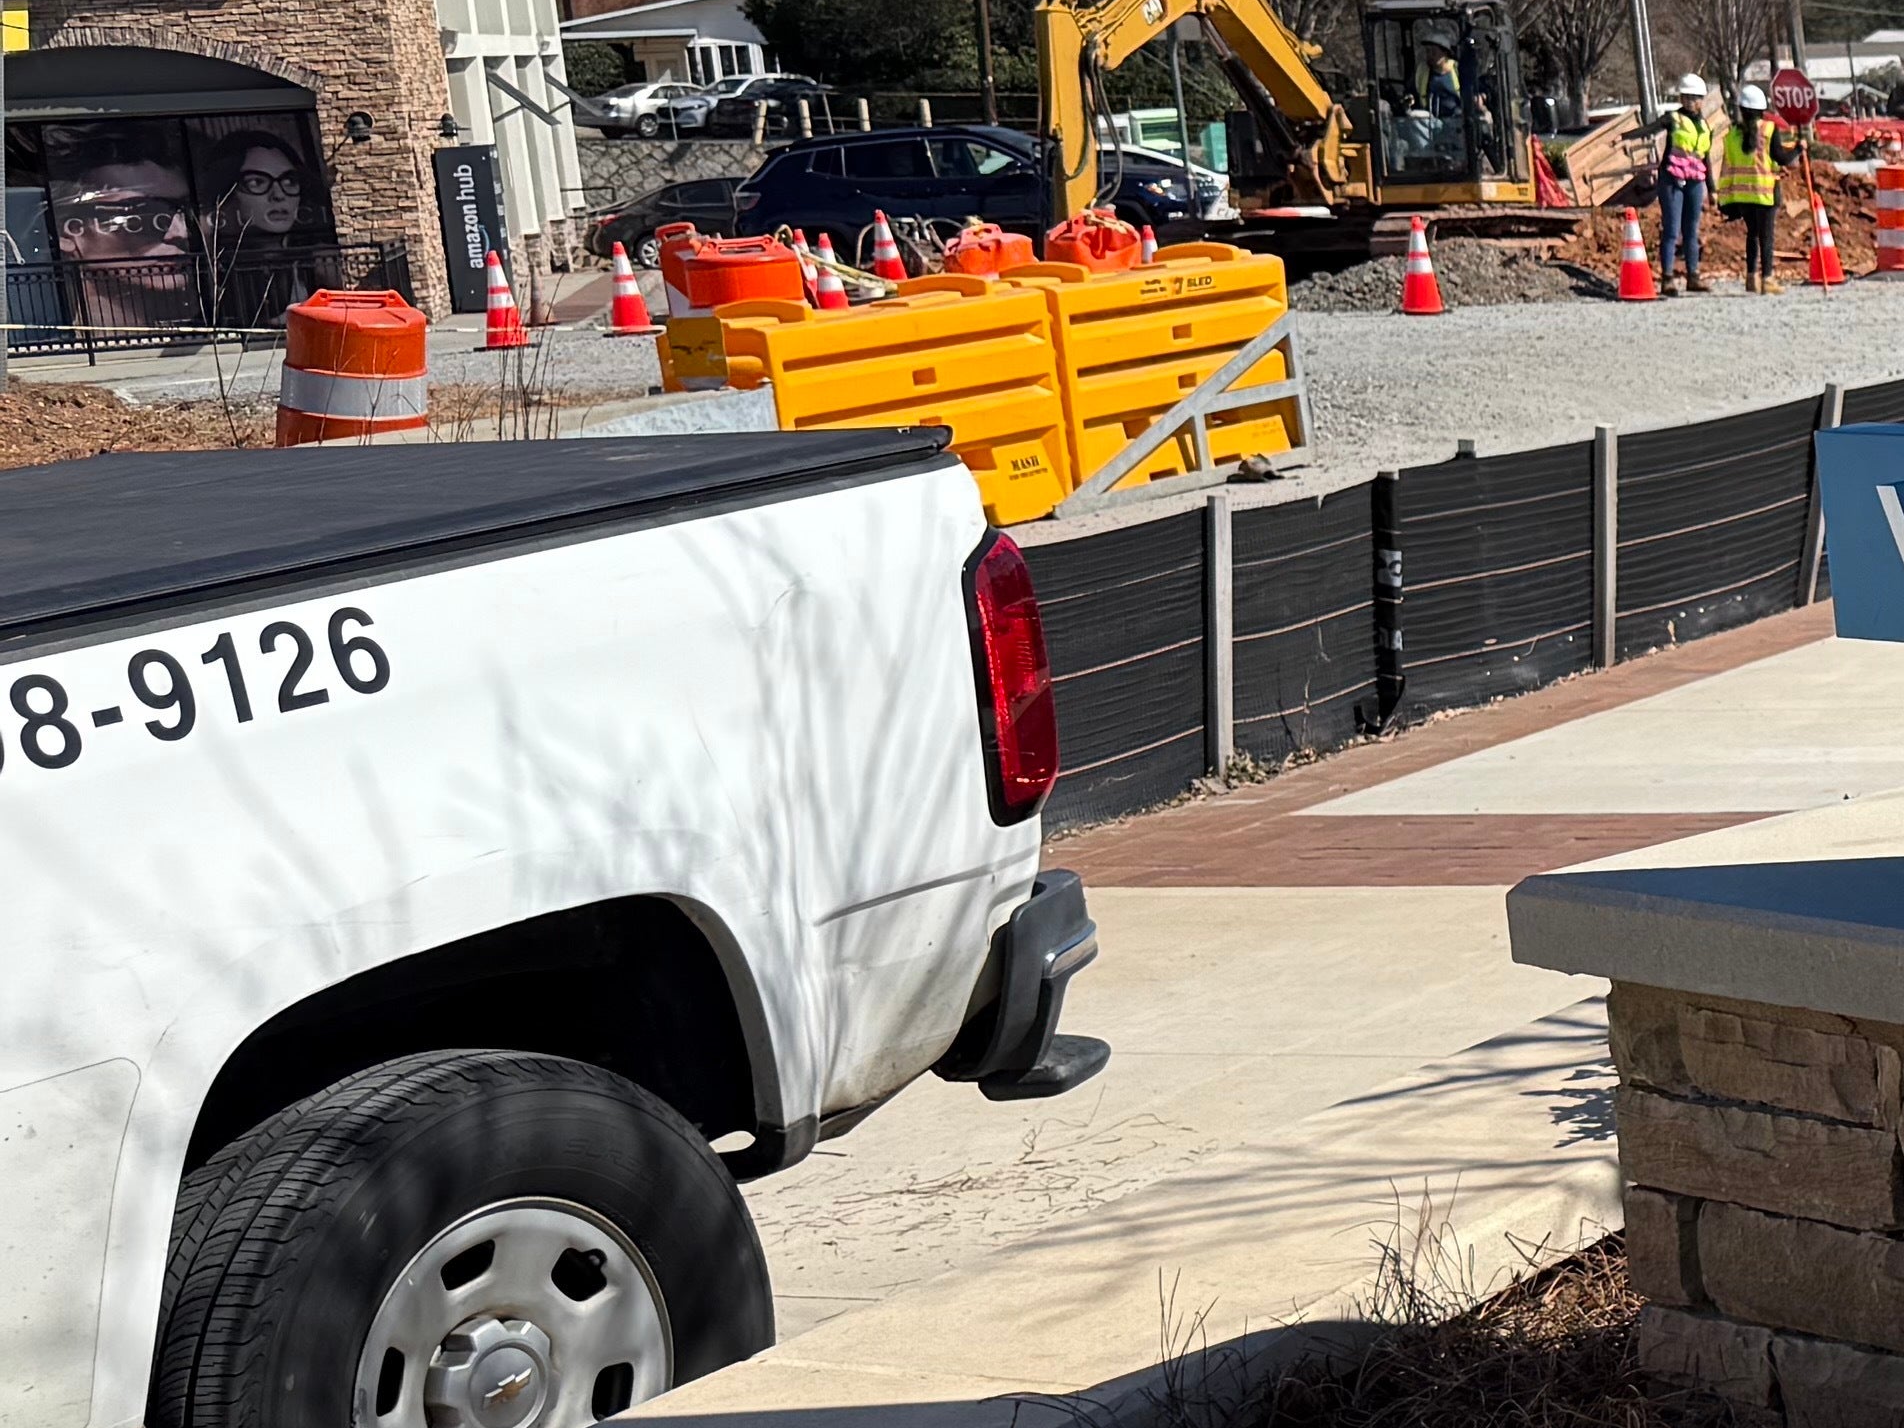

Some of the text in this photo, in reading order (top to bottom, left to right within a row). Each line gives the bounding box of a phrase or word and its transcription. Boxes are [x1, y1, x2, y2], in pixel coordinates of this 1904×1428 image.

[1774, 86, 1814, 109] STOP
[63, 212, 175, 237] GUCC
[453, 164, 485, 269] amazon hub
[0, 606, 391, 772] 8-9126
